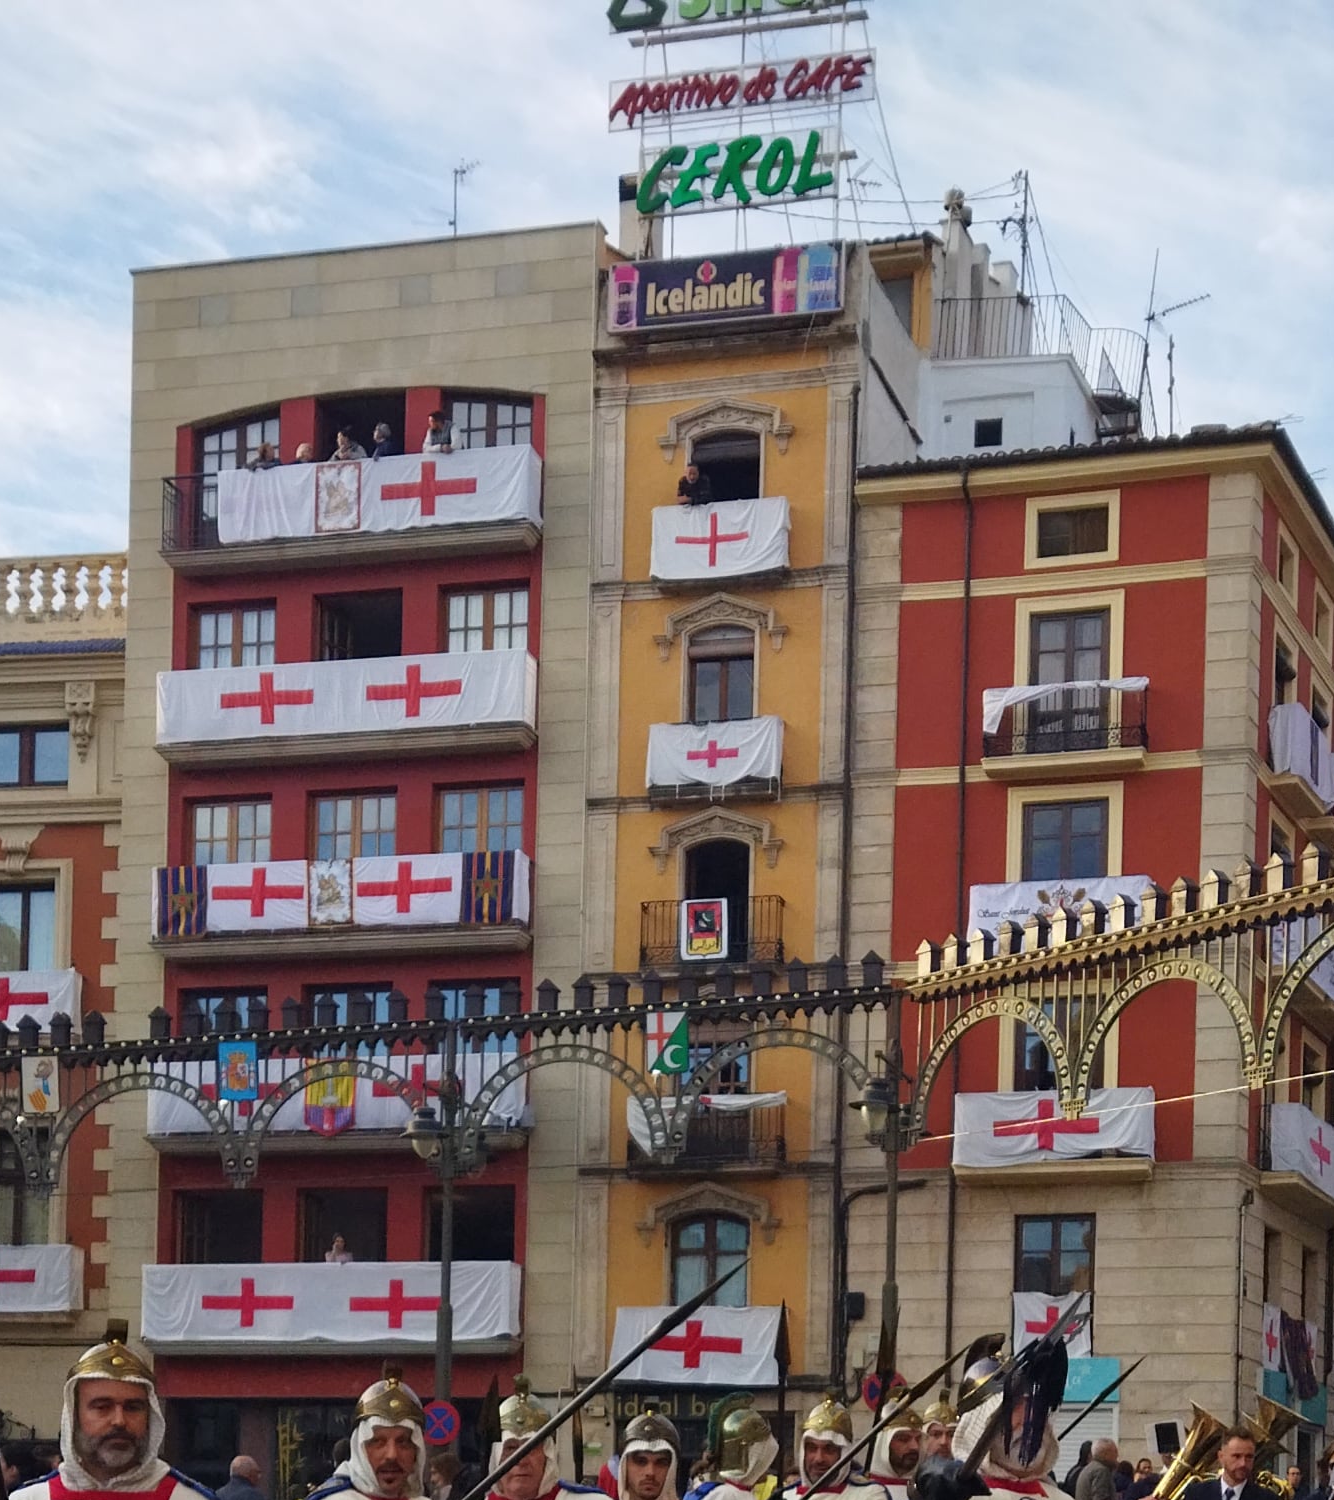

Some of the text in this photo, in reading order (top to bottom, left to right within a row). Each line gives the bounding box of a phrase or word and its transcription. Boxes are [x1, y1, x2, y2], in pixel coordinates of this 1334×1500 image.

[743, 64, 778, 105] de
[636, 130, 833, 214] CEROL
[645, 272, 765, 316] Icelandic
